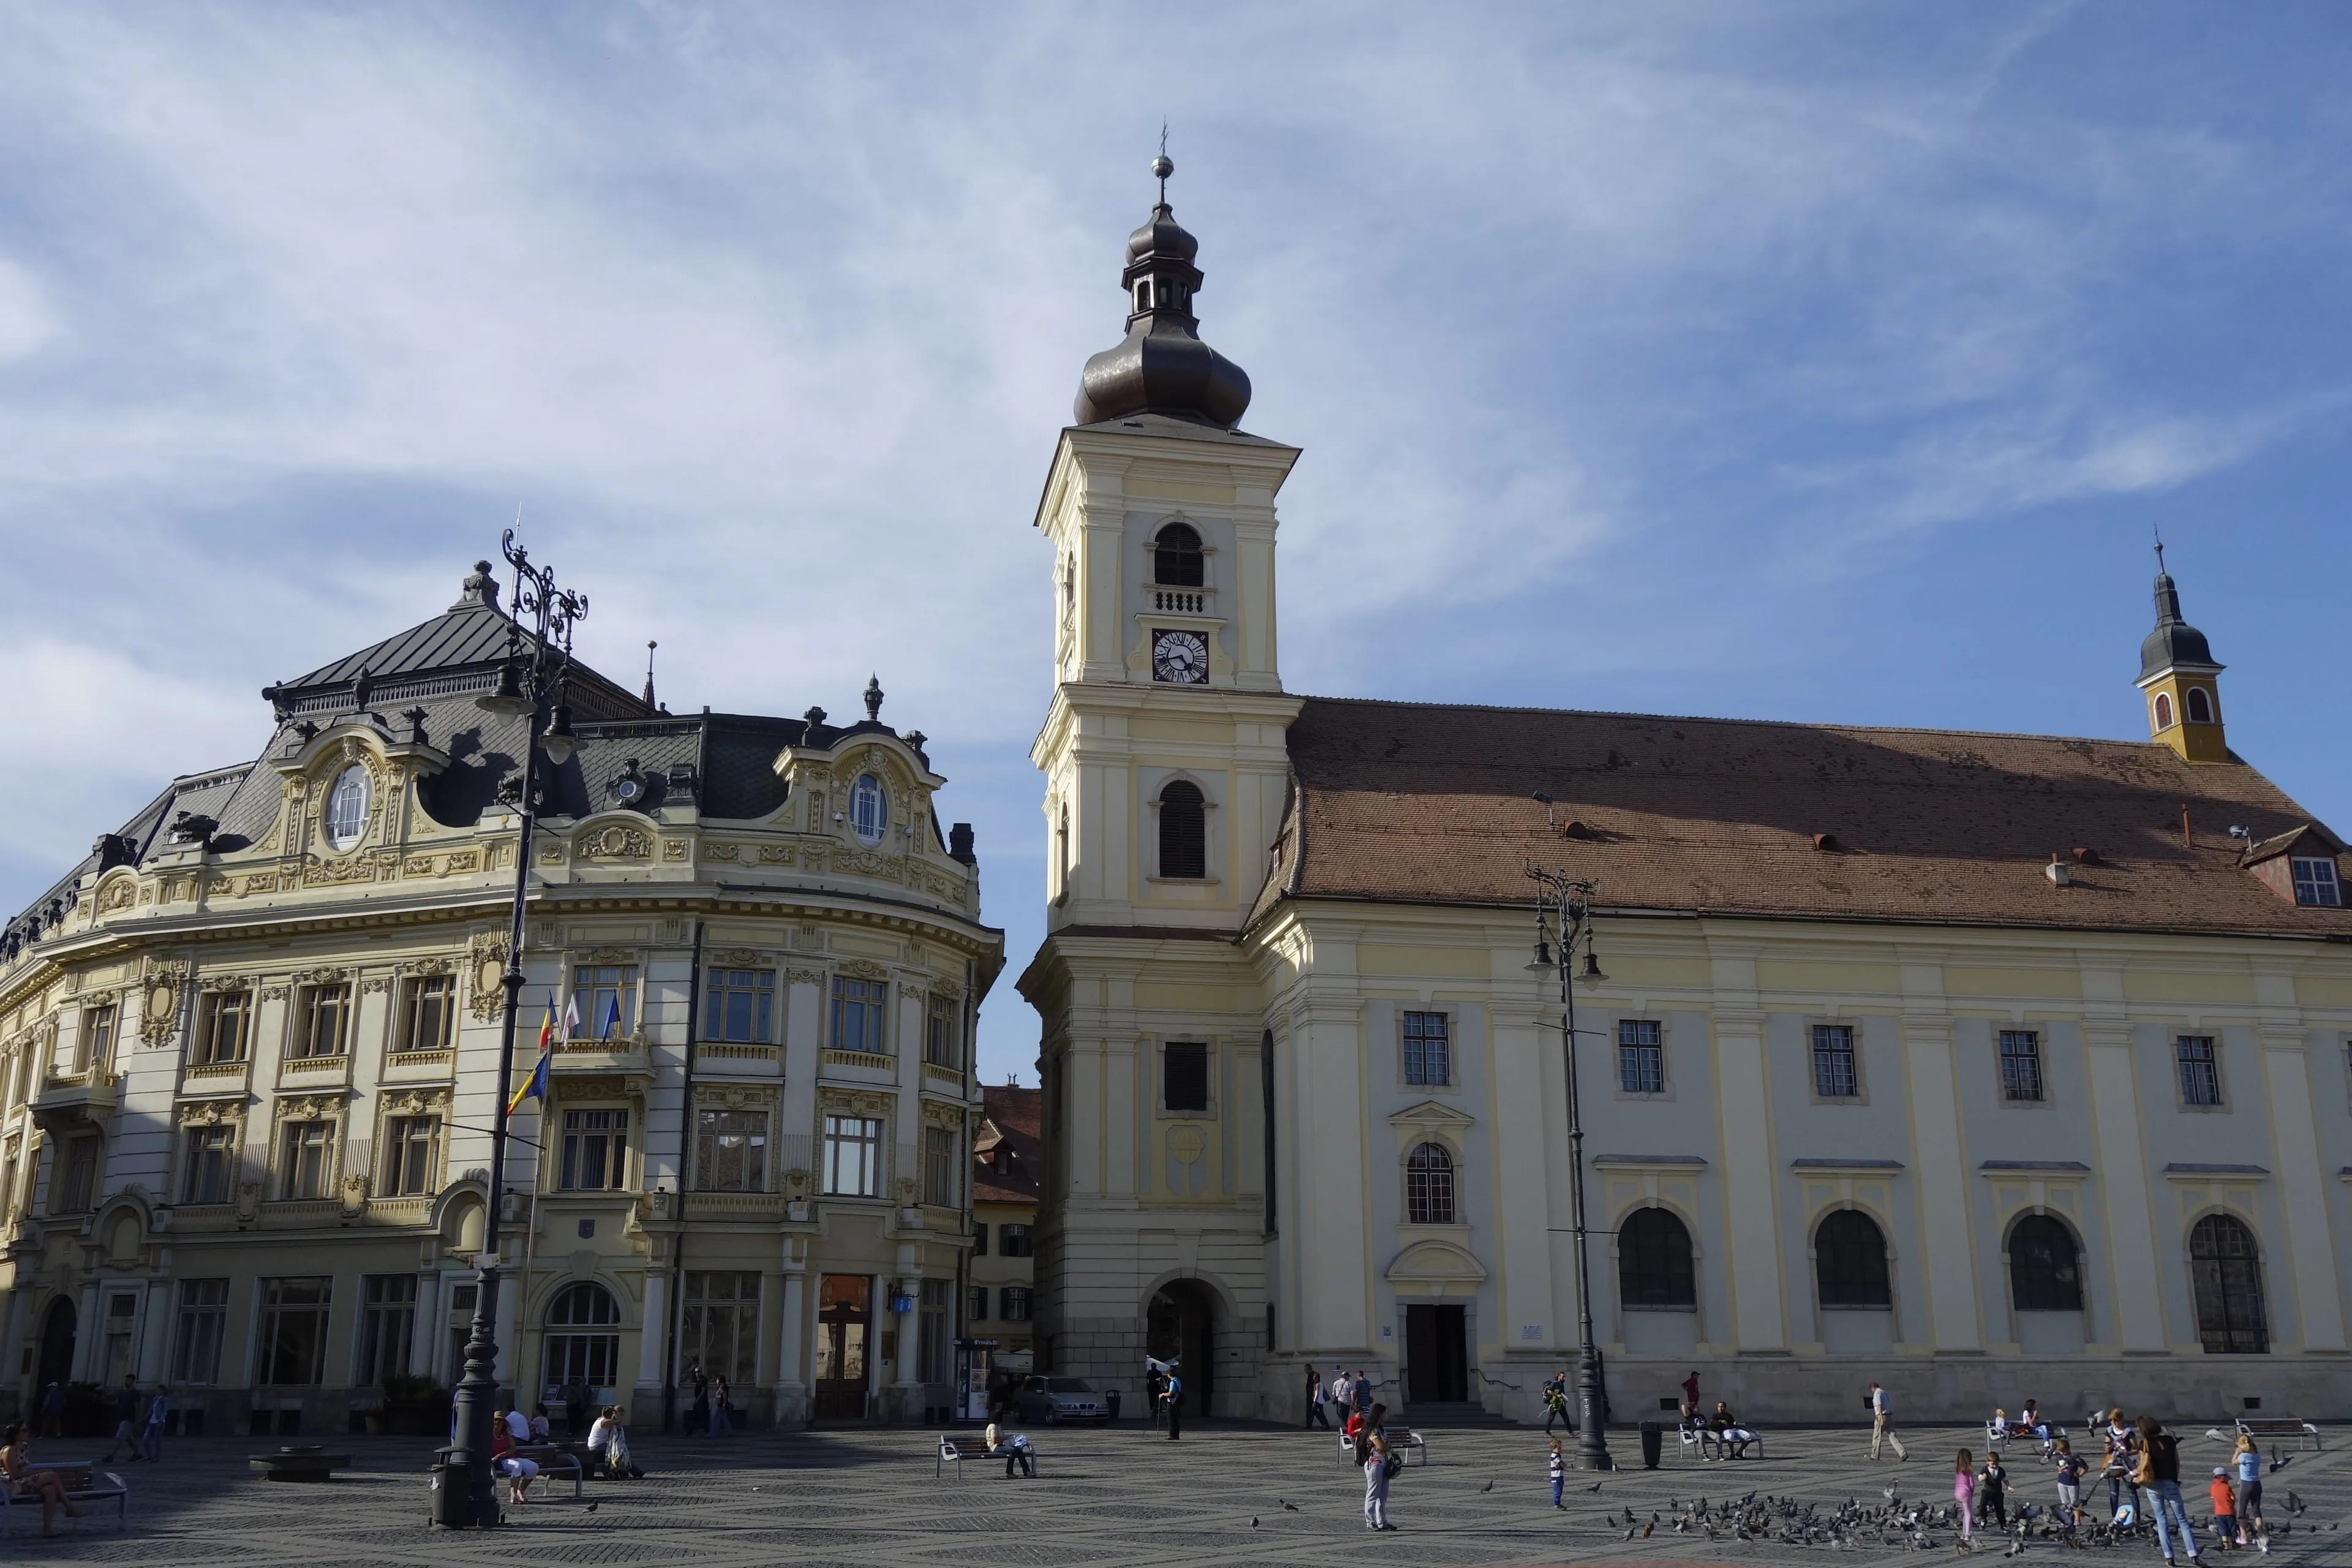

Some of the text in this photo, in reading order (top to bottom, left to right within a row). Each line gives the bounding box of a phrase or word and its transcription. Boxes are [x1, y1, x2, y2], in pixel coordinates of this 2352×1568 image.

[1164, 633, 1175, 646] XI
[1175, 632, 1186, 644] XII
[1188, 637, 1194, 646] I
[1157, 642, 1169, 652] X
